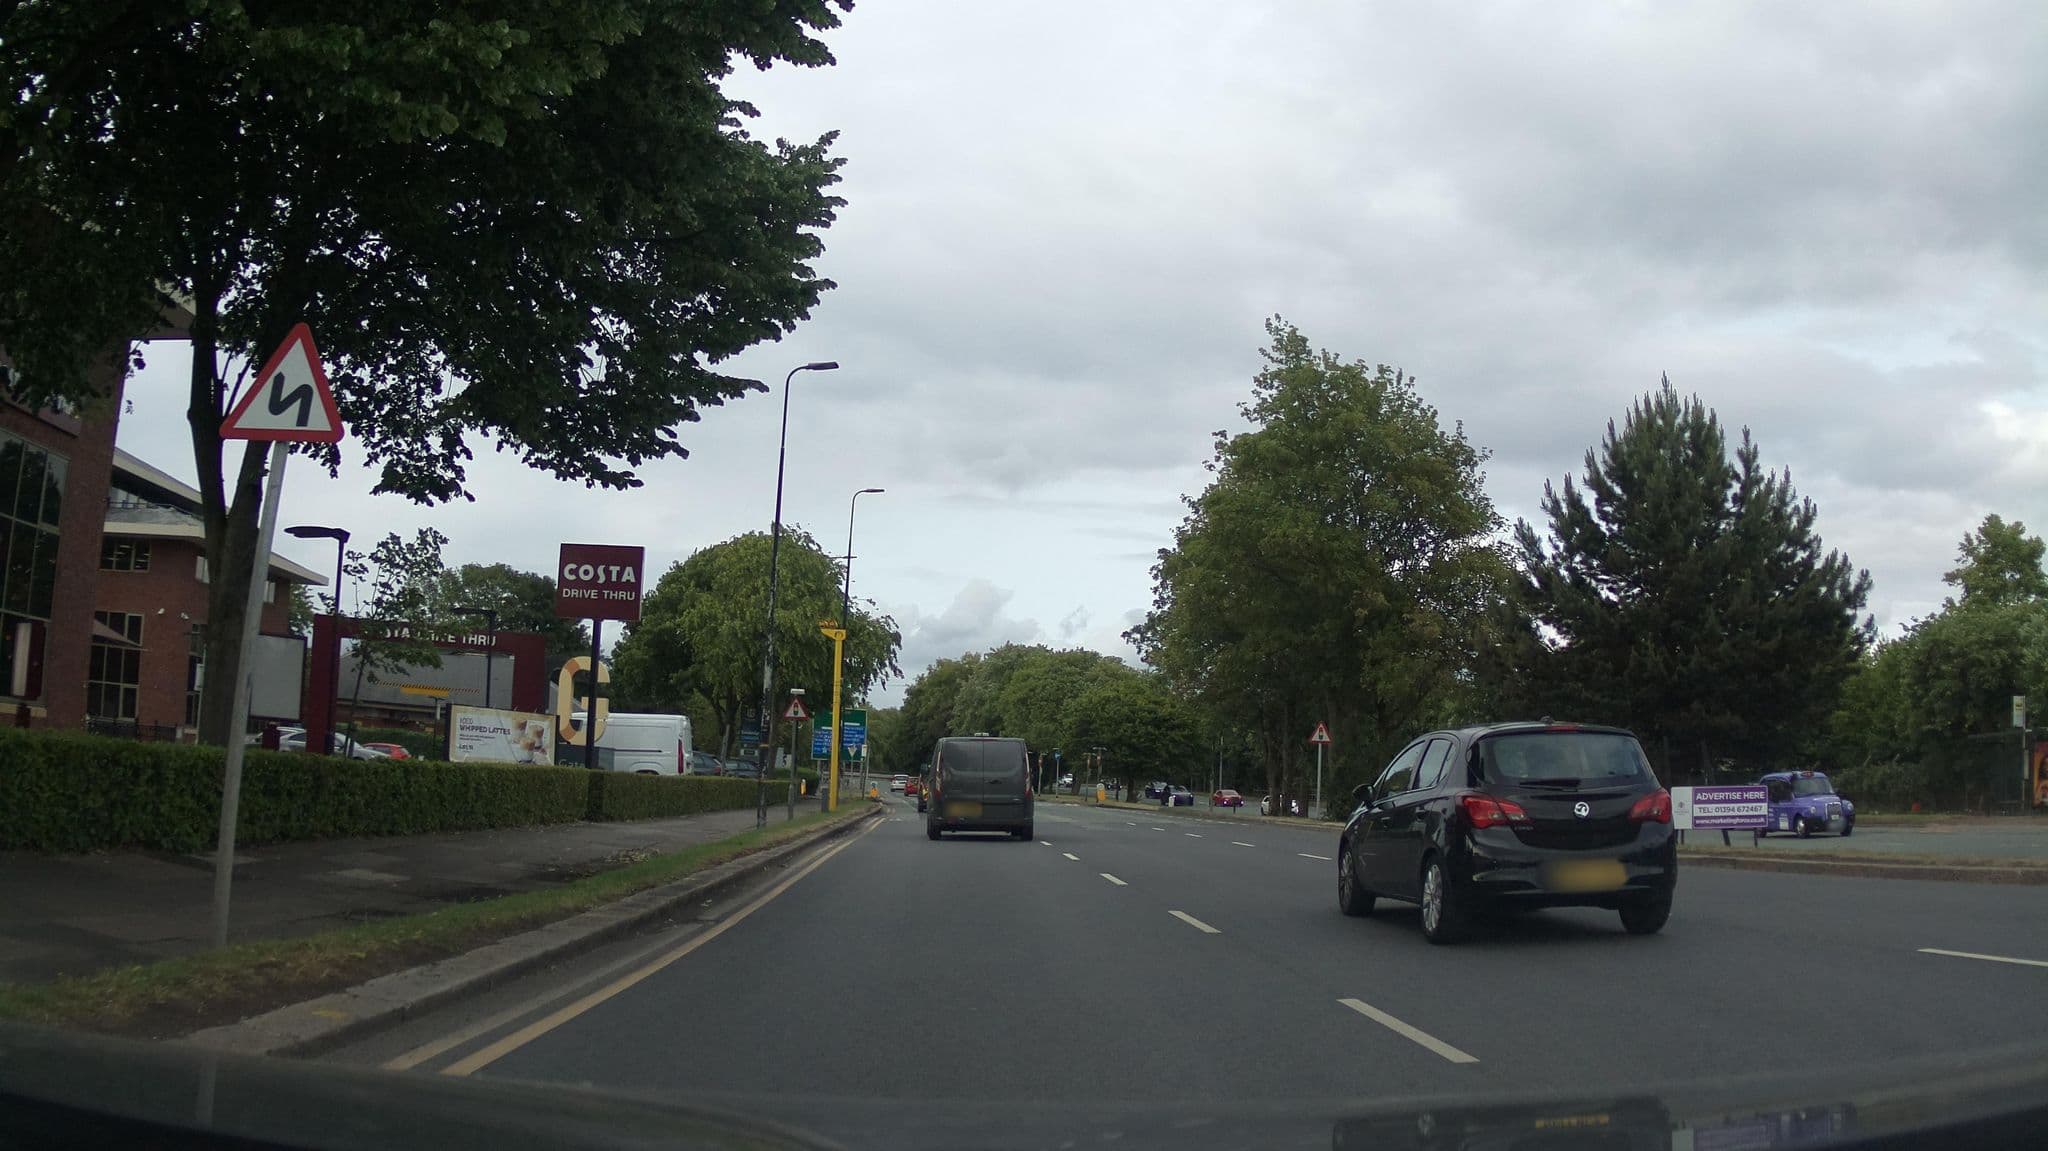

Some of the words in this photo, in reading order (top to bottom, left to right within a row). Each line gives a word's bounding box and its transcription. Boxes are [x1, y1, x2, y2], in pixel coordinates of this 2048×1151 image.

[563, 563, 636, 584] COSTA
[562, 588, 598, 599] DRIVE
[602, 590, 636, 601] THRU
[1696, 792, 1742, 800] ADVERTISE
[1743, 791, 1765, 799] HERE
